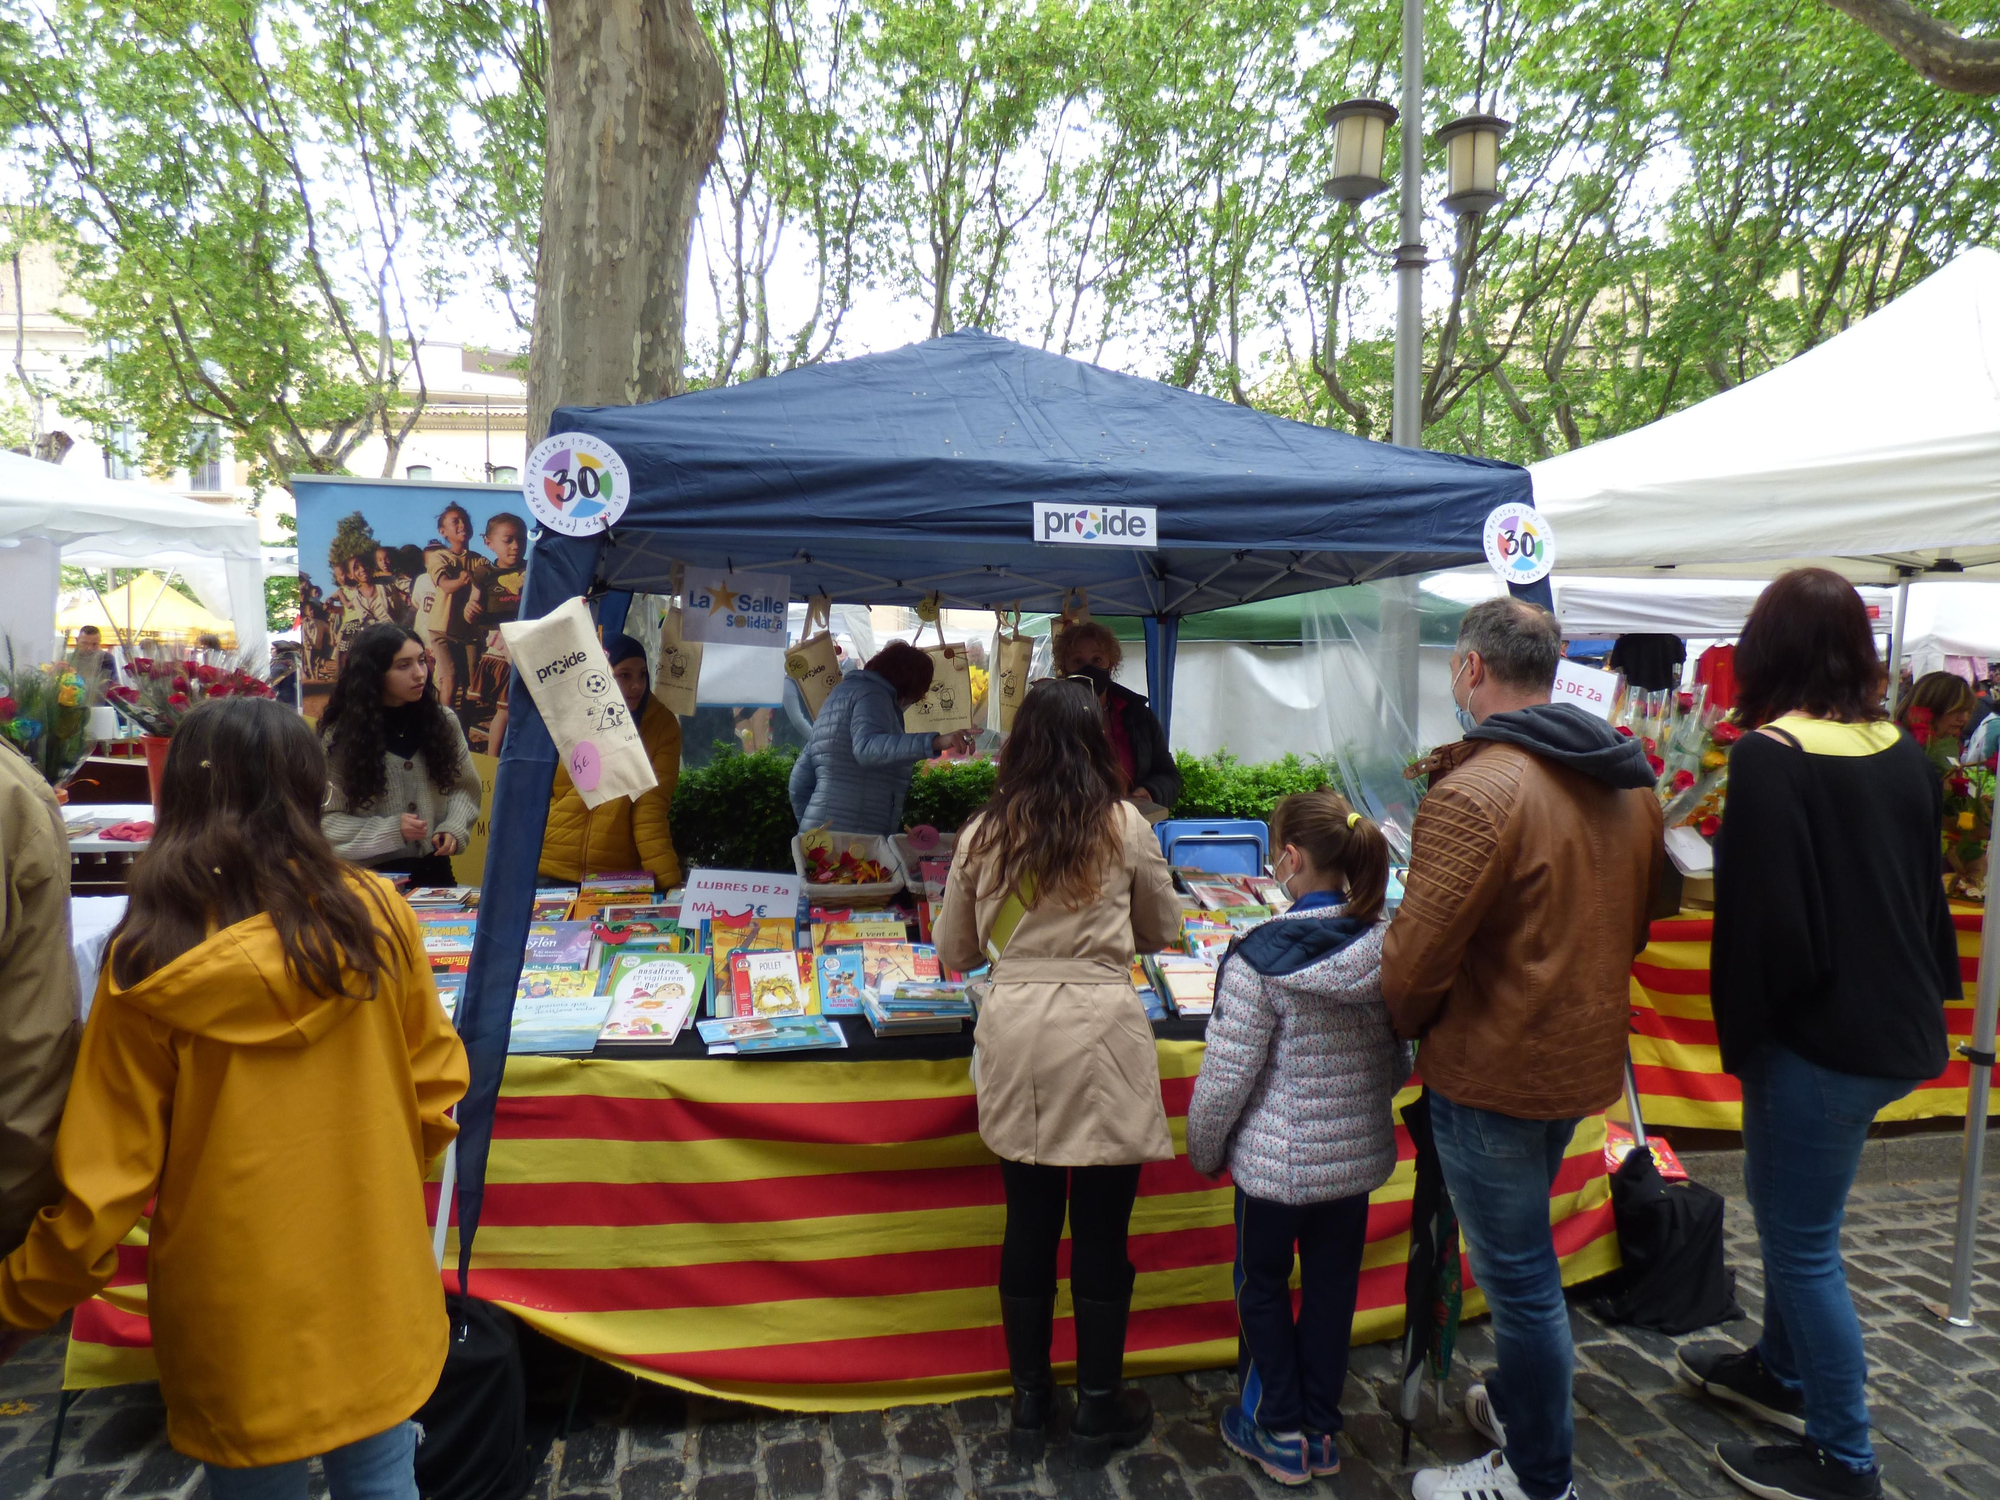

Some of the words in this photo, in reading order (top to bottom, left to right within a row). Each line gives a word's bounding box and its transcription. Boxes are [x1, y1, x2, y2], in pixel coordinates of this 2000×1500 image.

[553, 466, 600, 502] 30
[1504, 530, 1535, 557] 30
[689, 590, 710, 609] La
[738, 594, 785, 614] Salle
[119, 628, 160, 637] Aacus
[1566, 682, 1584, 697] DE
[1586, 688, 1603, 703] 2a
[696, 881, 748, 892] LLIBRES
[751, 885, 770, 894] DE
[773, 886, 790, 895] 2a
[691, 901, 715, 913] MÀ
[759, 961, 782, 971] POLLET
